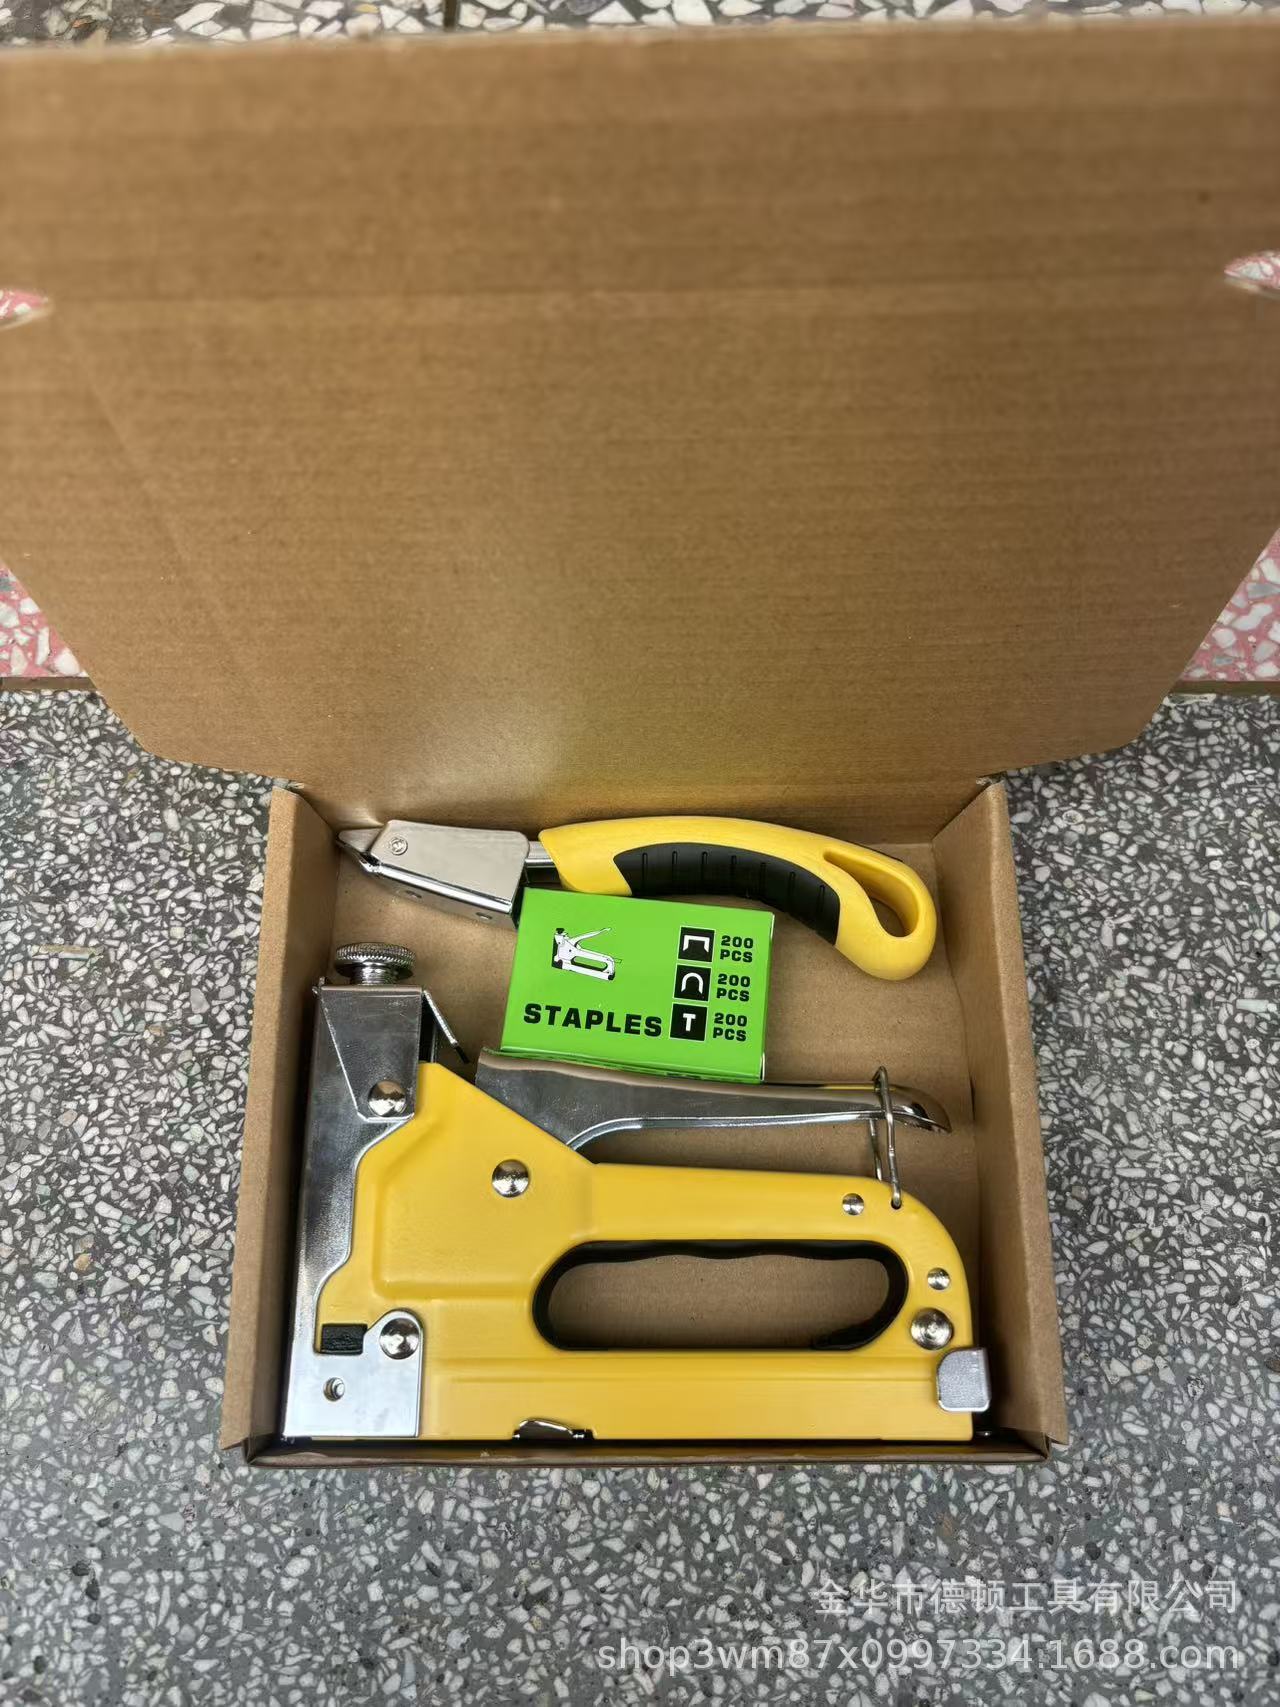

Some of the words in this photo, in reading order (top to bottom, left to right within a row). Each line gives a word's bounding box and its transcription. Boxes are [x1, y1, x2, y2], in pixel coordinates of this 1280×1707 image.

[720, 935, 754, 949] 200
[719, 949, 753, 963] PCS
[717, 973, 751, 988] 200
[716, 988, 750, 1002] PCS
[523, 1003, 662, 1037] STAPLES
[714, 1012, 748, 1027] 200
[712, 1027, 747, 1042] PCS
